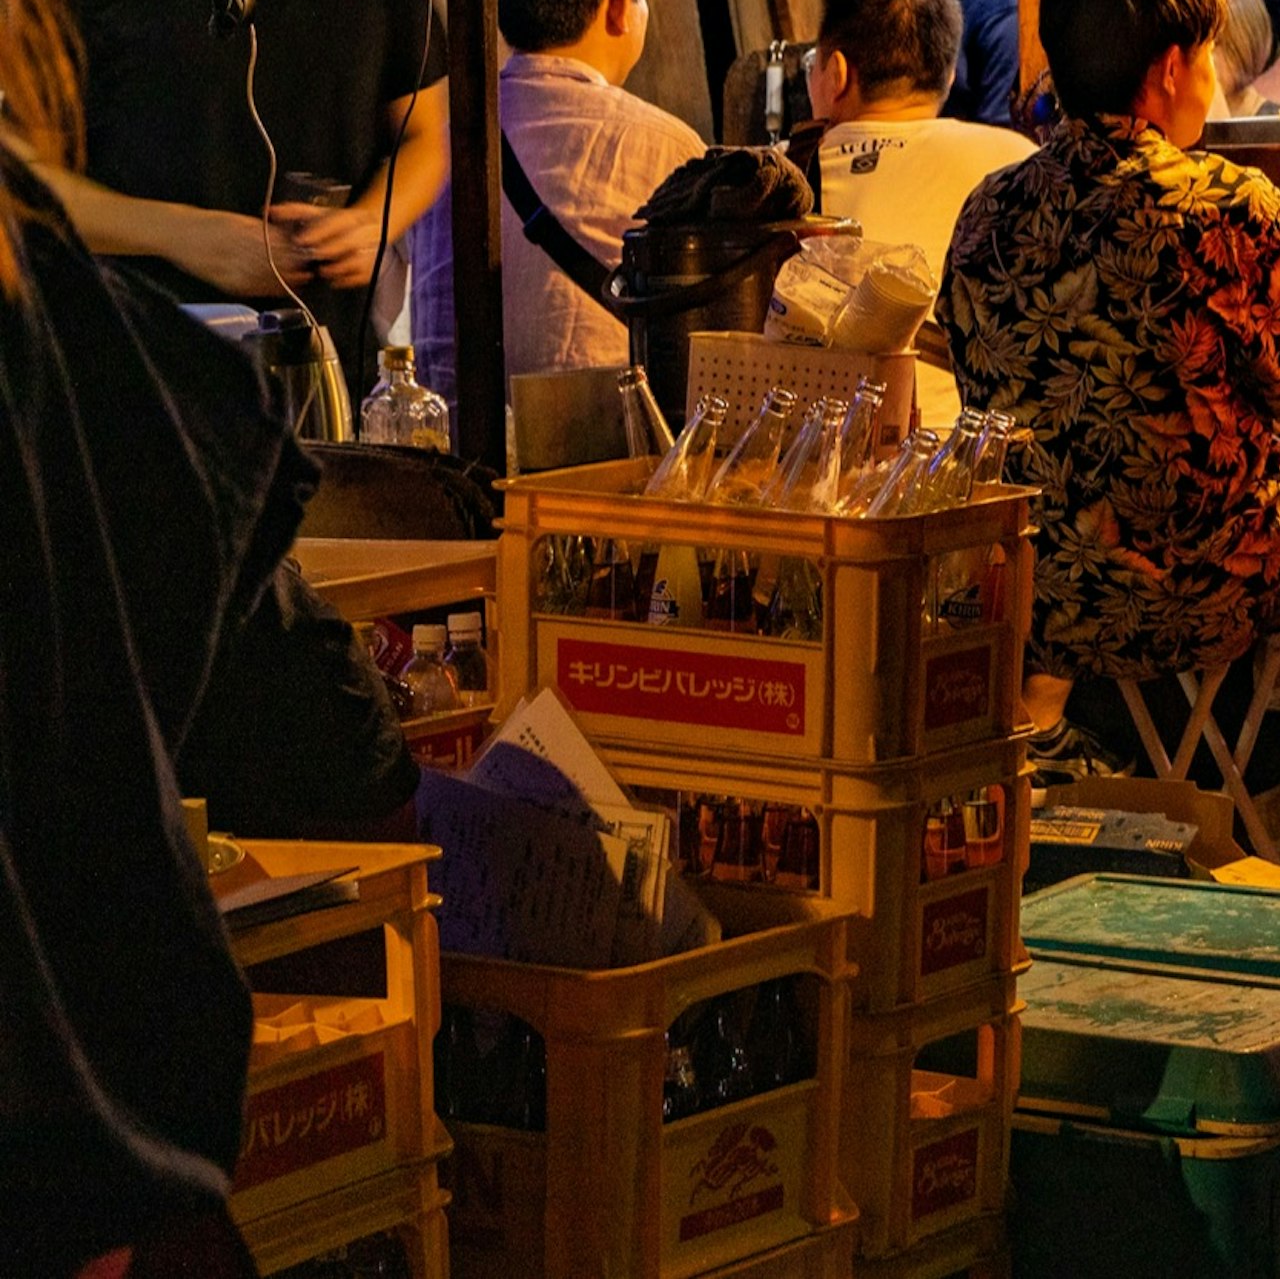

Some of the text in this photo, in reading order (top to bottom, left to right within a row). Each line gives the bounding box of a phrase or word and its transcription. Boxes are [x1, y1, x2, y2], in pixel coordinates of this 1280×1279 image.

[568, 660, 797, 708] キリンビバレッジ(株)
